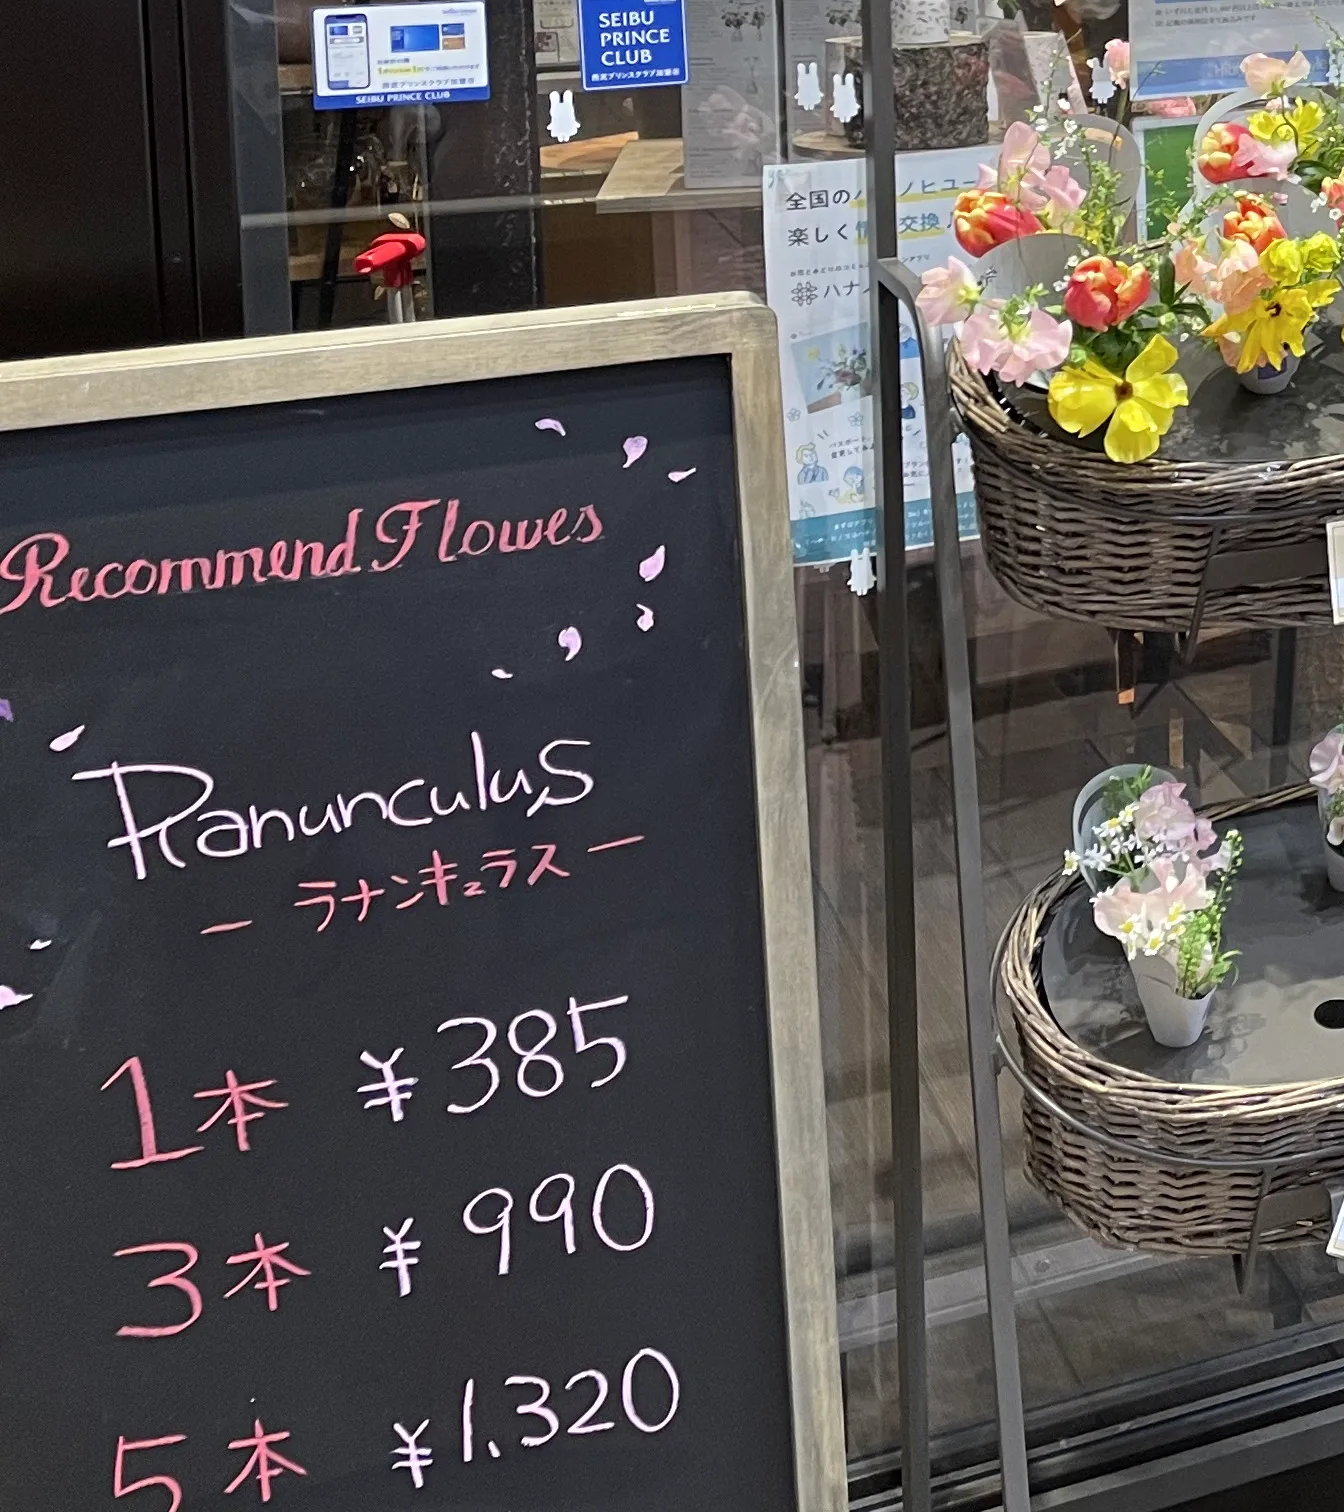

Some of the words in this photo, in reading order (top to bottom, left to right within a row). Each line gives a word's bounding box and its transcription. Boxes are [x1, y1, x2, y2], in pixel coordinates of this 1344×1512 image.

[598, 10, 655, 29] SEIBU
[600, 28, 671, 48] PRINCE
[601, 48, 653, 67] CLUB
[355, 93, 385, 105] SEIBU
[387, 91, 422, 103] PRINCE
[424, 90, 451, 102] CLUB
[0, 507, 363, 615] Recommend
[71, 731, 595, 880] Ranunculus
[293, 842, 571, 933] ラナンキュラス
[99, 1055, 290, 1170] 1本
[356, 994, 630, 1123] ¥385
[112, 1231, 312, 1338] 3本
[111, 1418, 308, 1512] 5本
